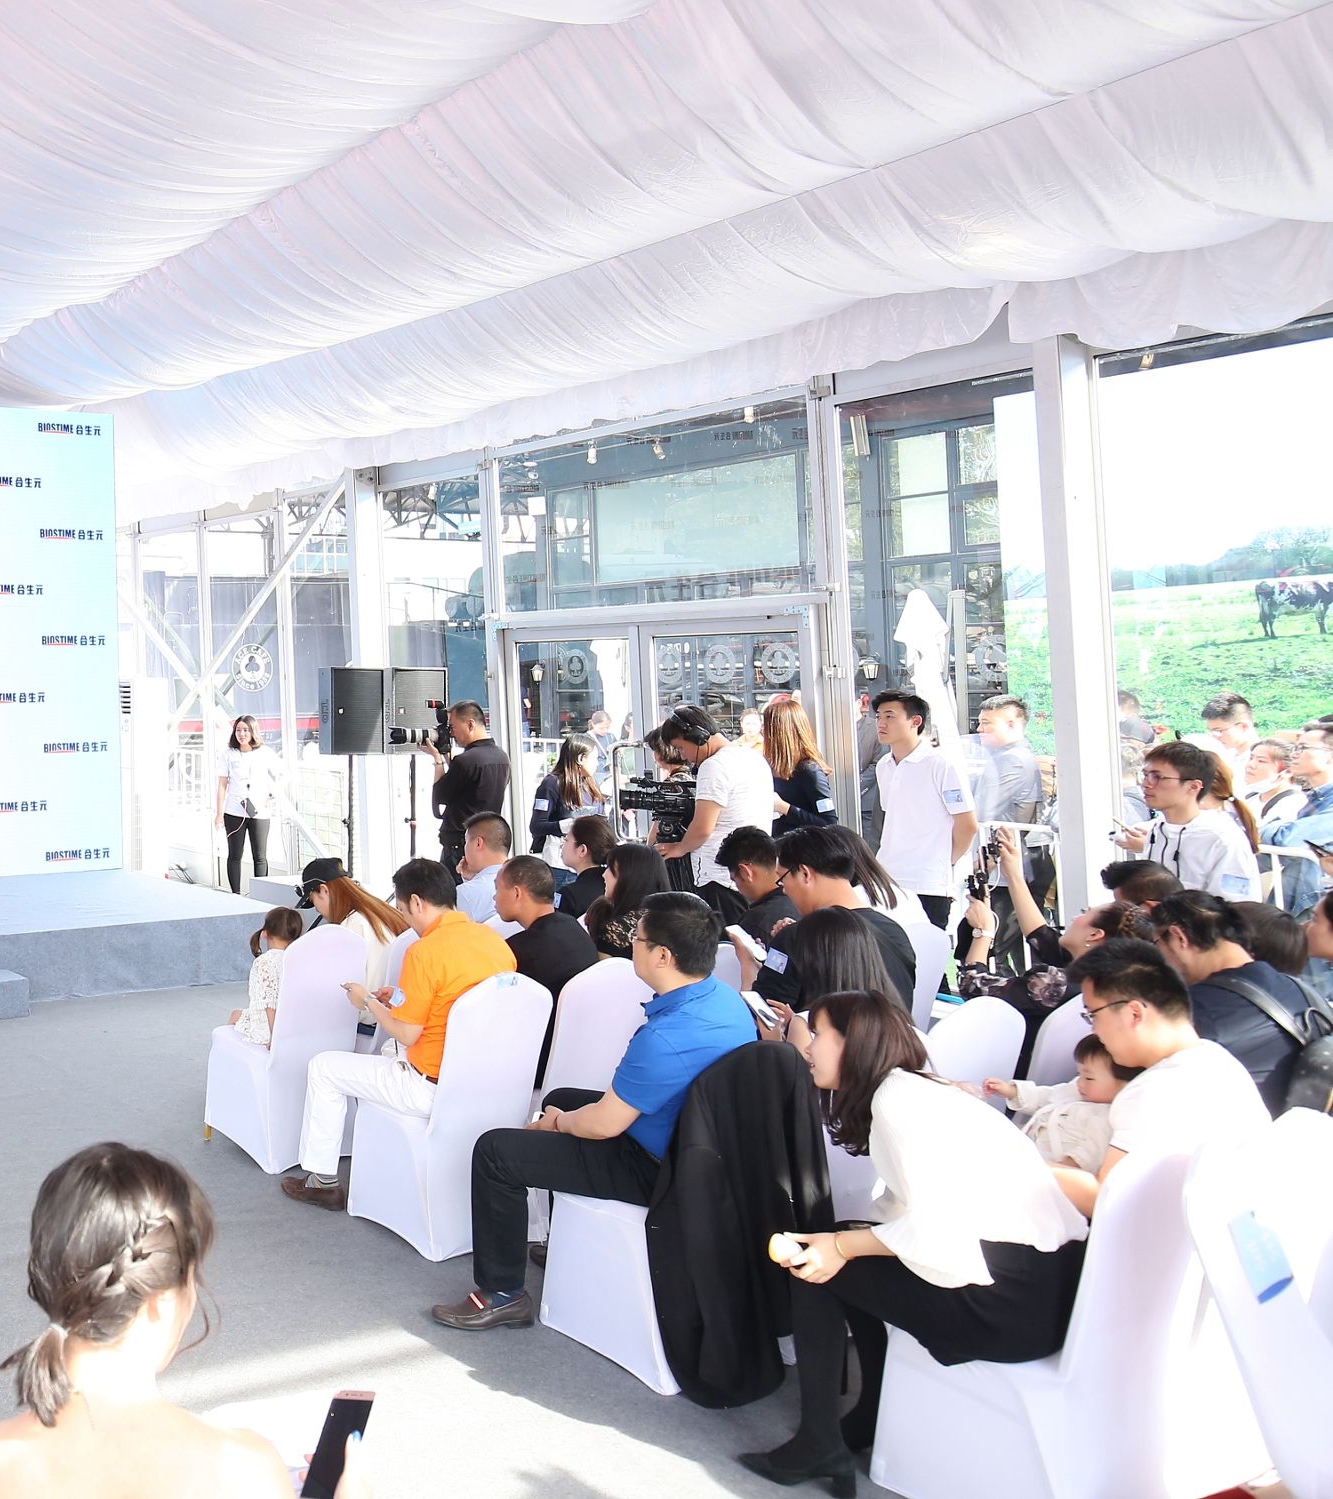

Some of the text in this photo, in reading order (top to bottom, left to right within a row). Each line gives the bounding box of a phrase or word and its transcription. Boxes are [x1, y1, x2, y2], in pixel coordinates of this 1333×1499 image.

[38, 423, 100, 436] BIOSTIME 合生元
[16, 477, 41, 488] 合生元
[40, 529, 103, 540] BIOSTIME 合生元
[18, 585, 43, 595] 合生元
[42, 636, 105, 645] BIOSTIME 合生元
[19, 692, 44, 703] 合生元
[44, 742, 107, 752] BIOSTIME 合生元
[21, 800, 46, 811] 合生元
[46, 848, 109, 861] BIOSTIME 合生元
